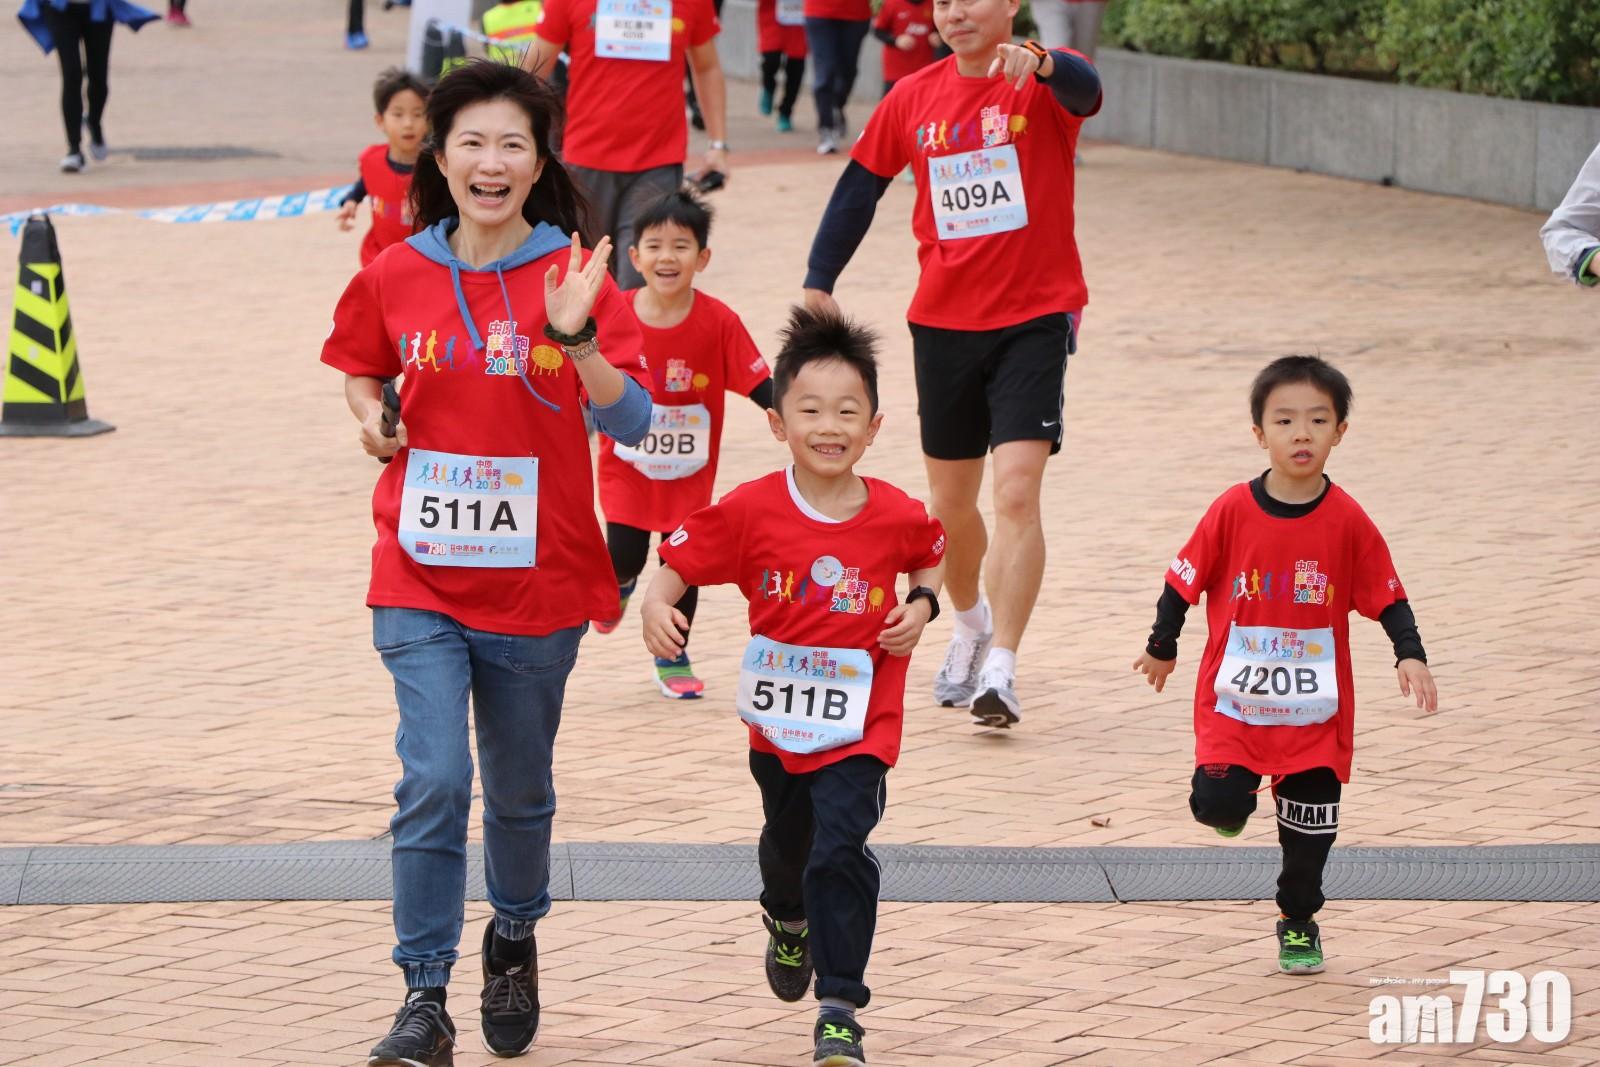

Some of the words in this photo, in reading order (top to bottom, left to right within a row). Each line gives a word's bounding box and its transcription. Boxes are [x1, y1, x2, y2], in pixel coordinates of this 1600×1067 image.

[942, 180, 1011, 212] 409A
[488, 320, 517, 336] 中原
[635, 433, 695, 455] 09B
[475, 480, 501, 490] 2019
[419, 495, 518, 532] 511A
[1295, 560, 1318, 573] 中原
[1293, 589, 1325, 604] 2019
[830, 598, 866, 614] 2019
[1281, 649, 1304, 658] 2019
[811, 668, 837, 679] 2019
[1230, 665, 1319, 696] 420B
[752, 680, 849, 721] 511B
[1286, 802, 1327, 825] MAN
